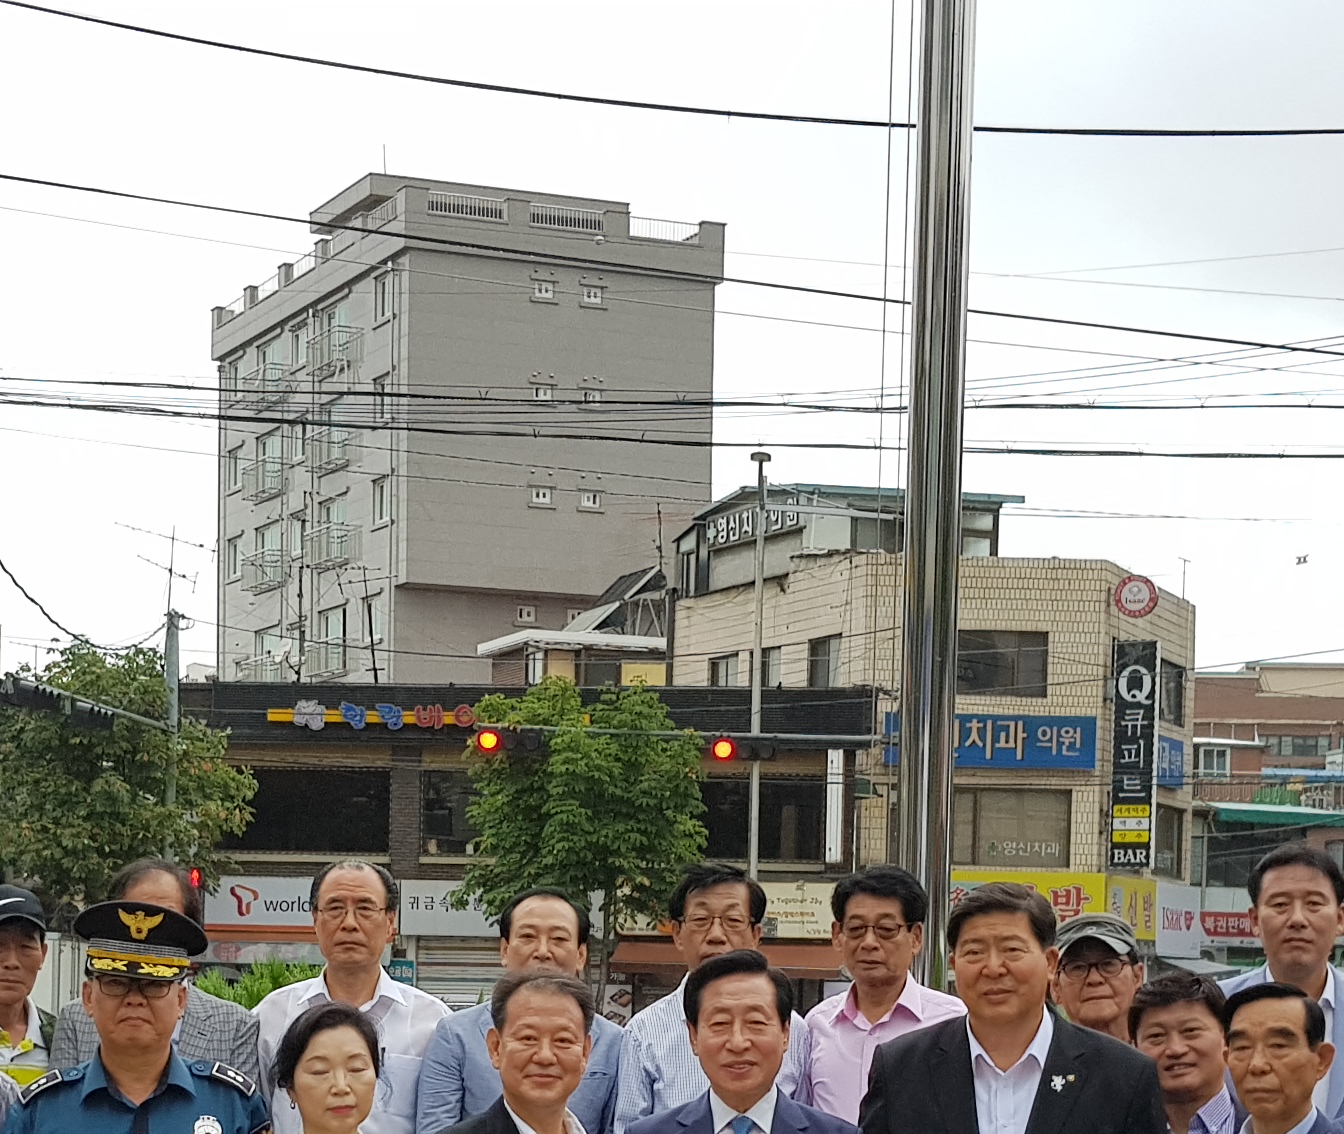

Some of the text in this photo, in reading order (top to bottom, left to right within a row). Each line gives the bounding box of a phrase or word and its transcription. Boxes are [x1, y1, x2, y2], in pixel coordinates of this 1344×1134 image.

[1036, 725, 1081, 756] 의원
[1003, 840, 1061, 858] 영신치과
[1113, 849, 1147, 864] BAR
